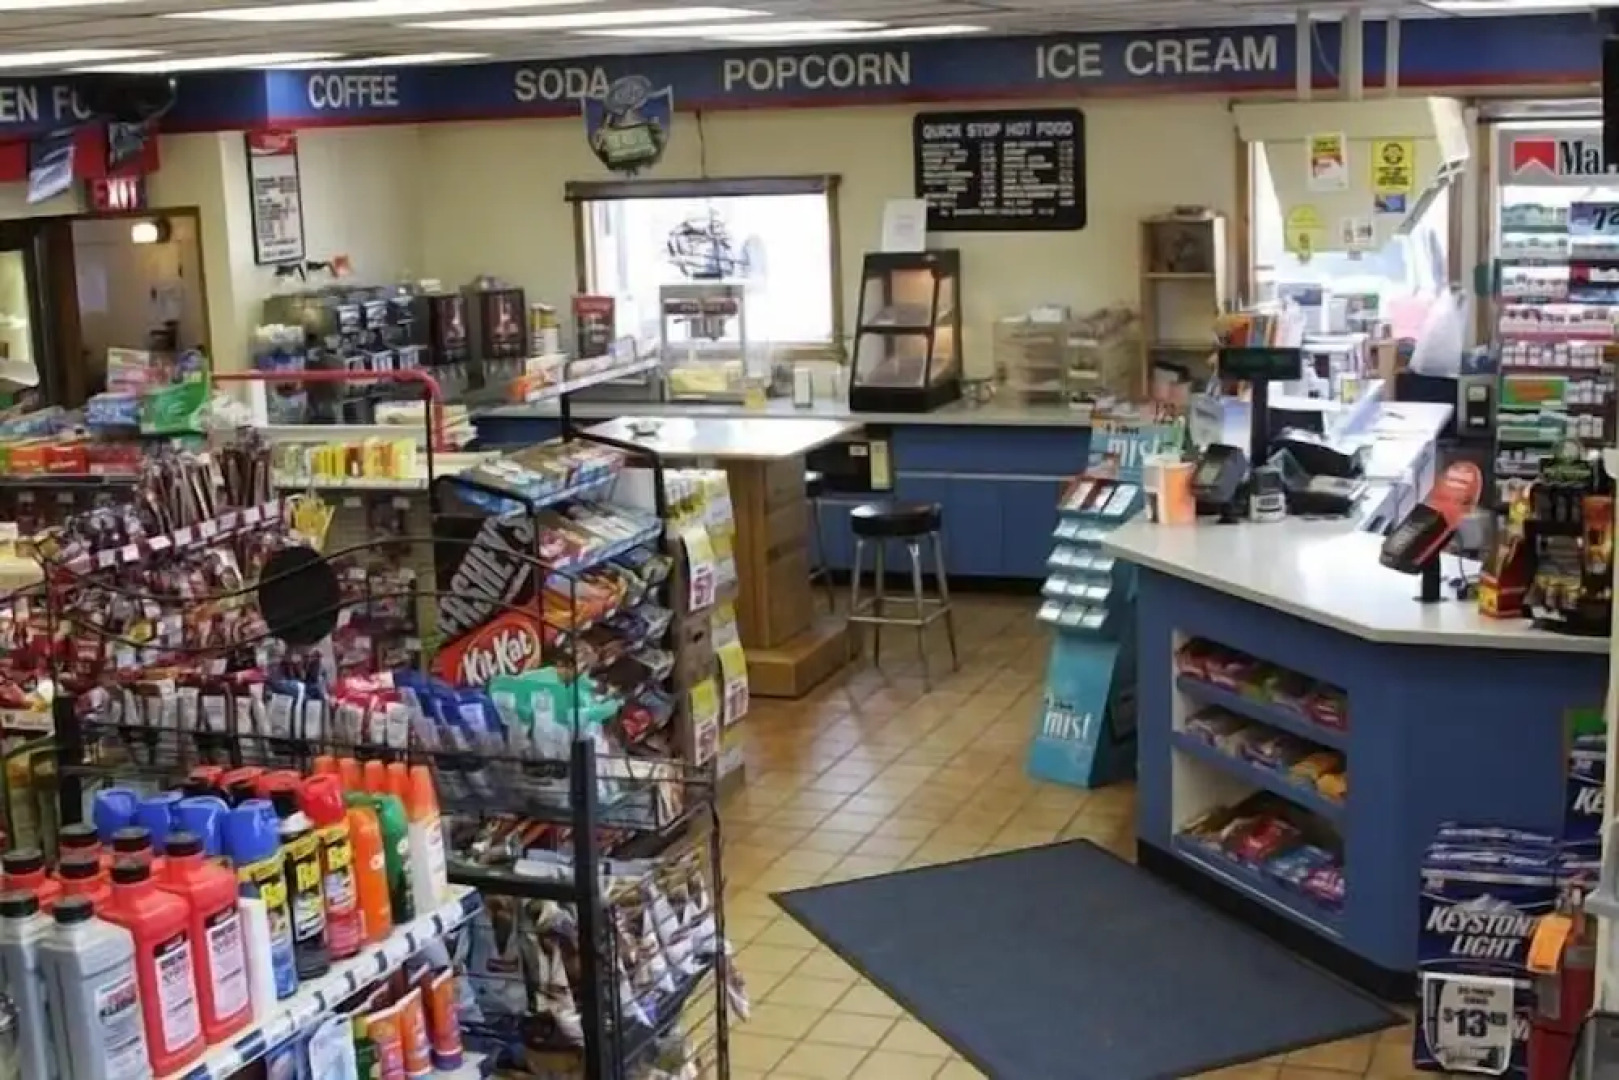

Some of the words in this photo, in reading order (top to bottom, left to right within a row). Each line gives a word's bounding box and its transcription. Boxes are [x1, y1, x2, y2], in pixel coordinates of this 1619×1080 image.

[724, 51, 911, 91] POPCORN
[1036, 42, 1102, 79] ICE
[1125, 35, 1278, 75] CREAM
[308, 74, 399, 108] COFFEE
[514, 66, 609, 101] SODA
[93, 177, 138, 209] EXIT
[1450, 934, 1522, 959] LIGHT
